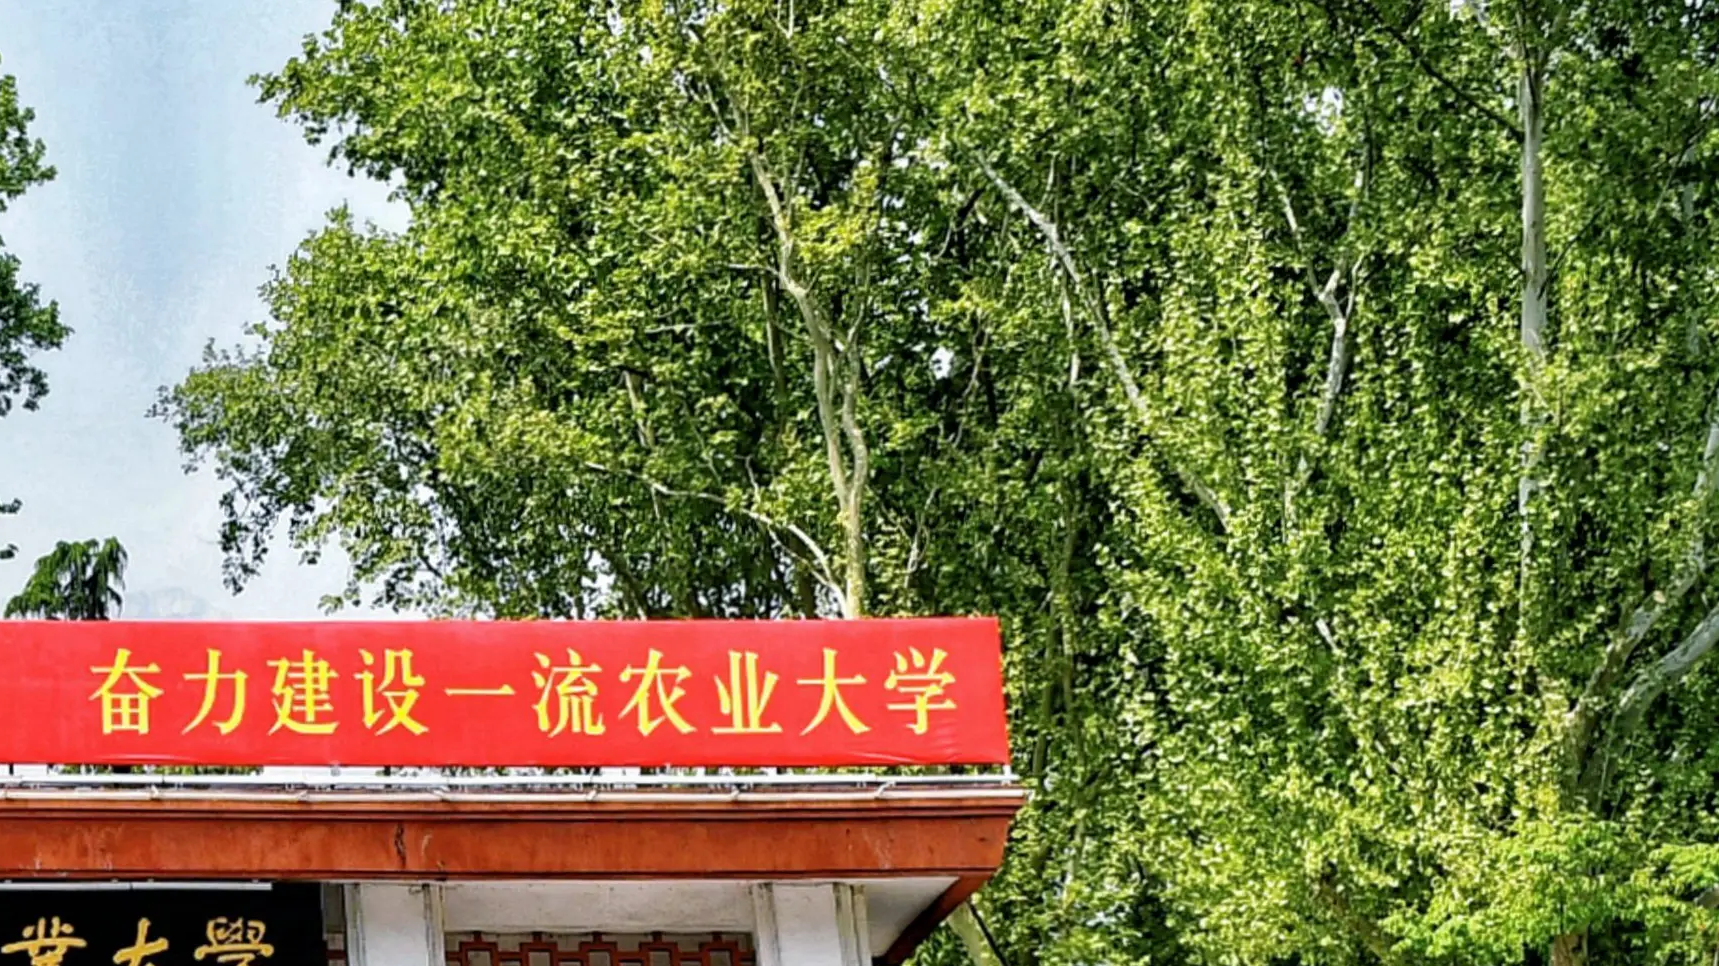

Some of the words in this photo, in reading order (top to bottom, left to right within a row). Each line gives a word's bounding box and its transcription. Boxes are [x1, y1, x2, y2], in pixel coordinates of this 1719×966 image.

[90, 646, 957, 737] 奋力建设一流农业大学
